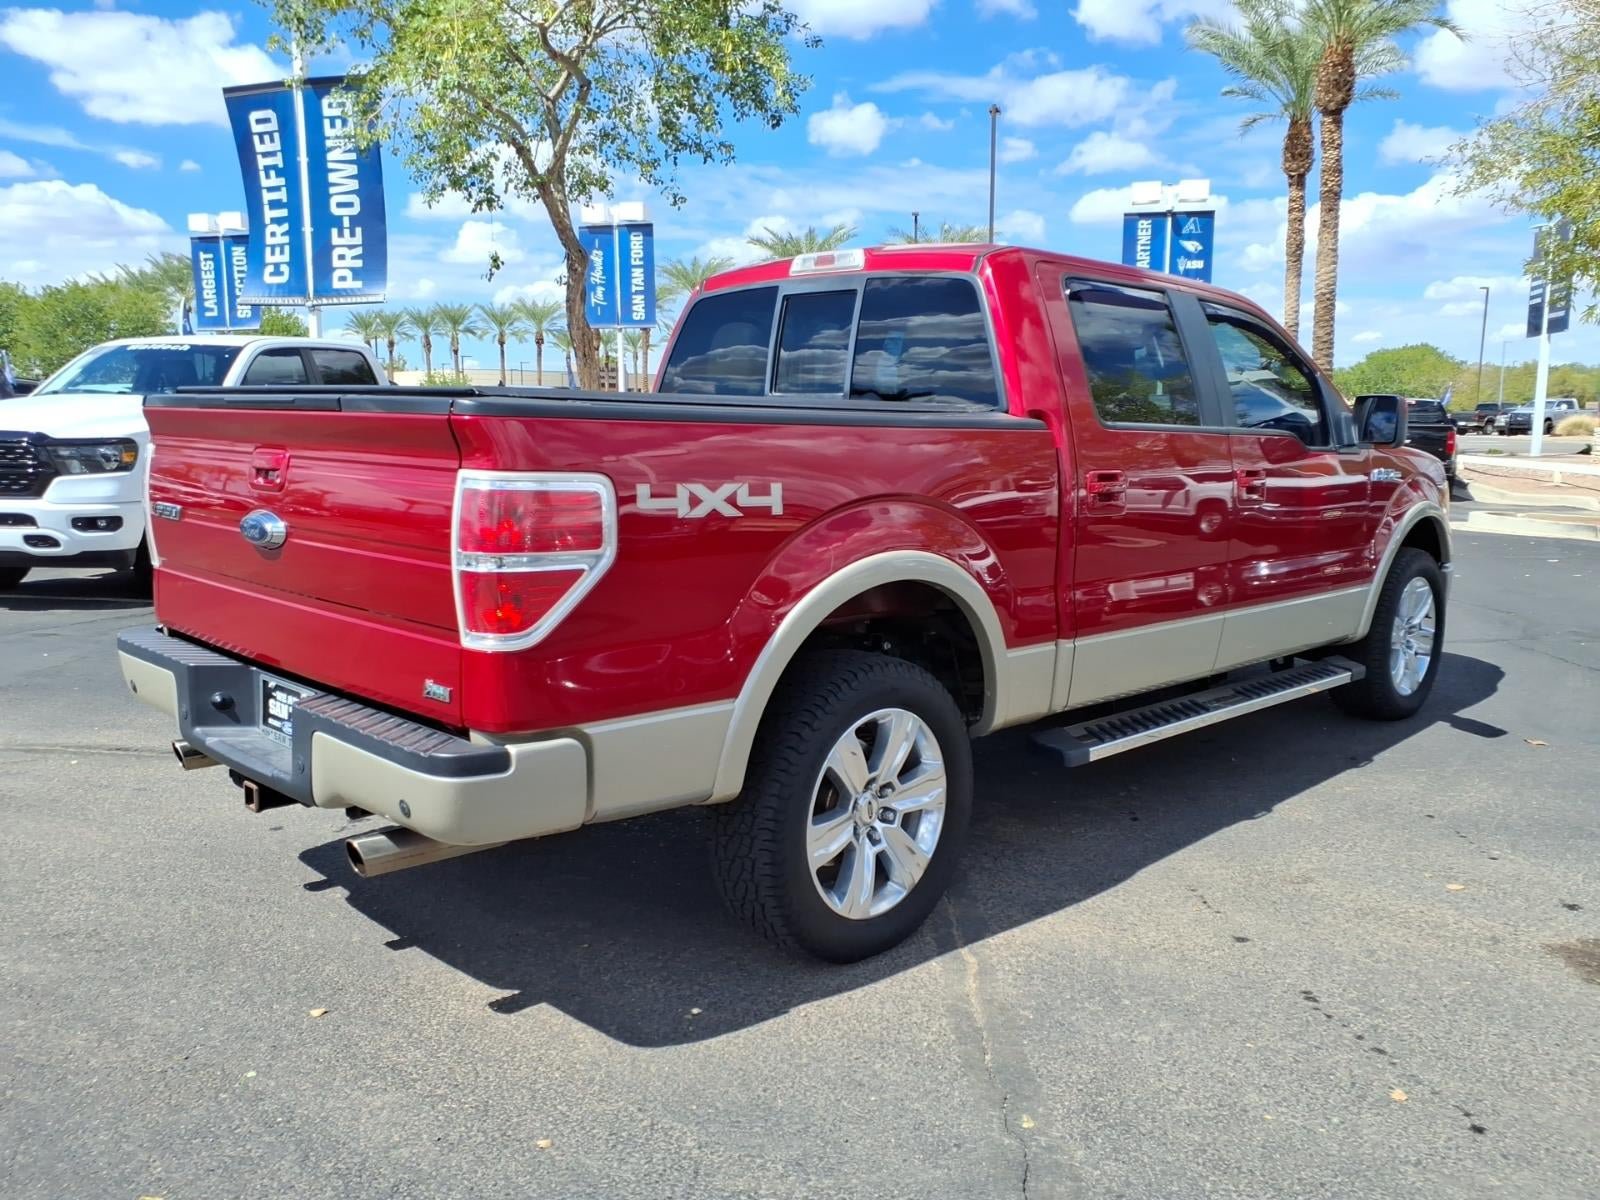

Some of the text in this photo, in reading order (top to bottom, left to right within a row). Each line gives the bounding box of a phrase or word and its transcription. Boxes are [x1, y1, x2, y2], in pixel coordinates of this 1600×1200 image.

[248, 108, 290, 285] CERTIFIED
[320, 96, 363, 289] PRE-OWNED
[630, 232, 645, 321] SAN TAN FORD
[1136, 219, 1153, 268] ARTNER
[1185, 259, 1205, 269] ASU
[198, 251, 218, 317] LARGEST
[231, 246, 252, 319] SECTION
[590, 286, 608, 307] Tim
[635, 481, 784, 519] 4X4
